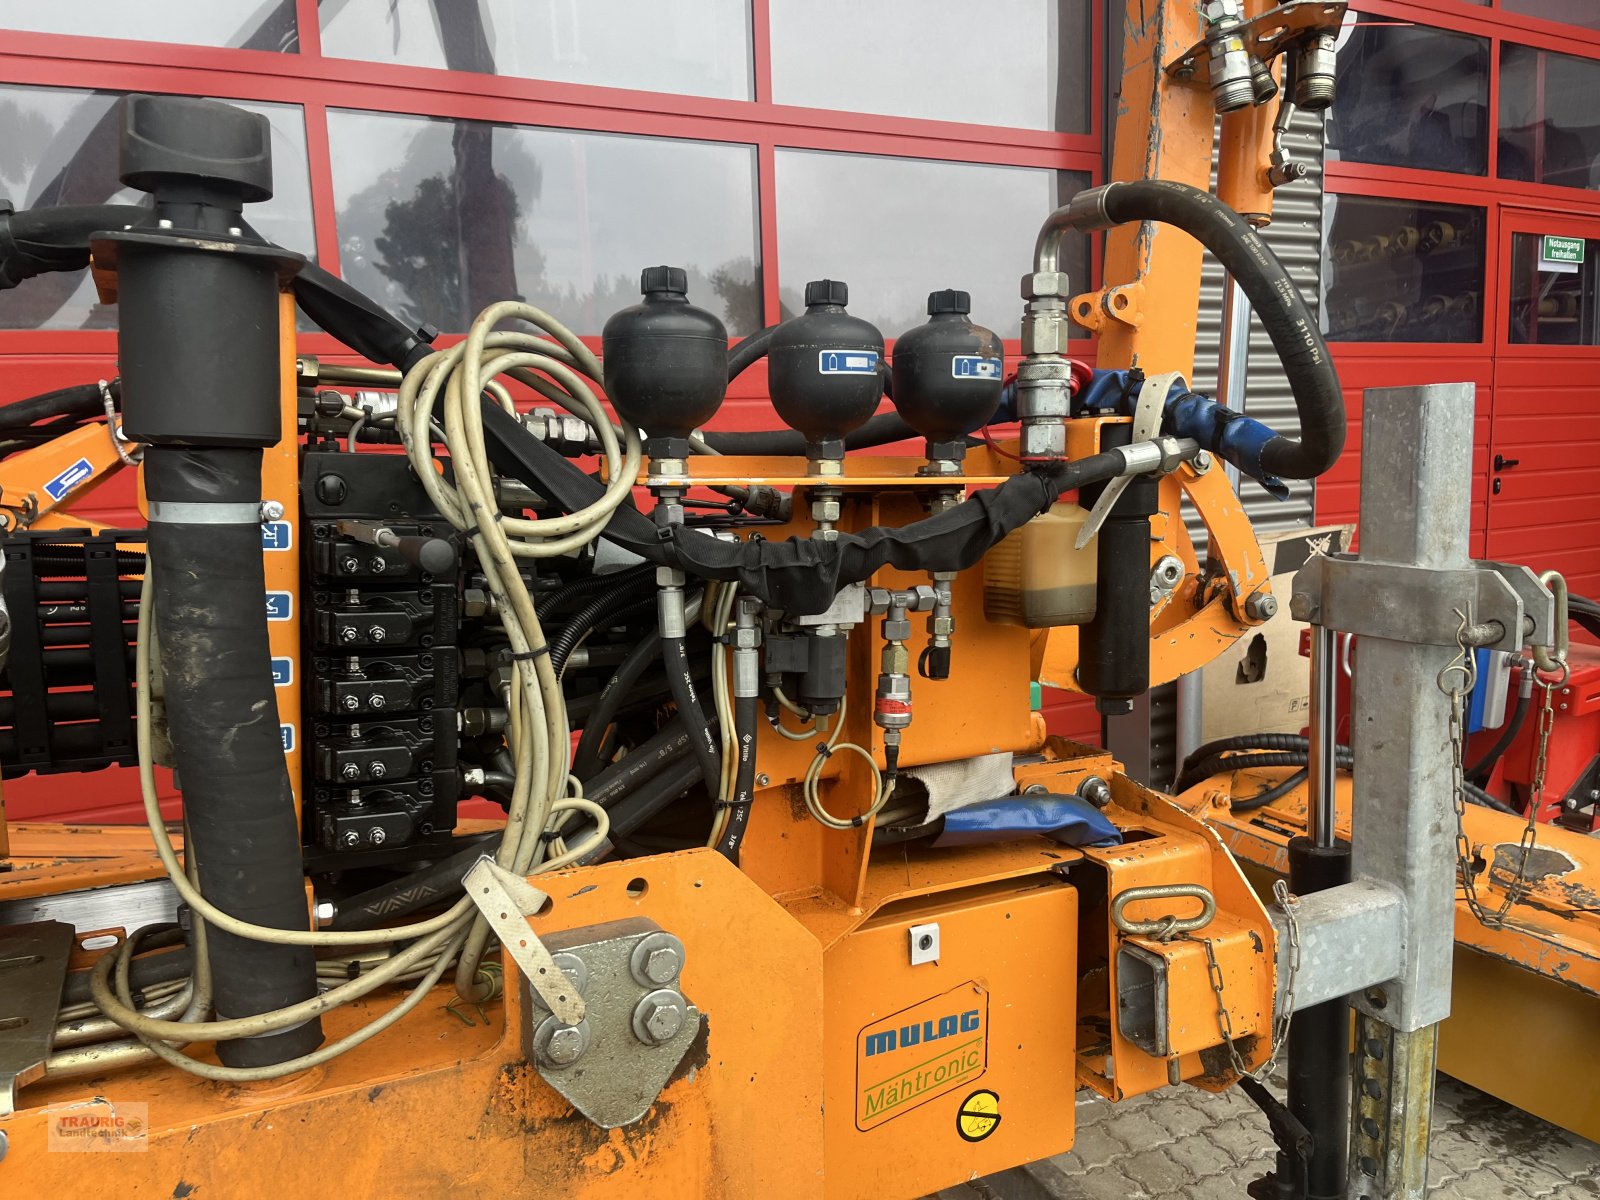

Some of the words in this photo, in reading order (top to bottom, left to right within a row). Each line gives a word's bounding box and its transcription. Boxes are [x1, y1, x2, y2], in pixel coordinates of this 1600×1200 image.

[1548, 238, 1580, 251] Notausgang
[1551, 248, 1577, 260] freihalten
[1296, 318, 1315, 347] 3110
[1309, 347, 1323, 365] Psi
[742, 744, 750, 762] Vitillo
[735, 808, 745, 822] 2SC
[865, 1009, 980, 1057] MULAG
[865, 1050, 979, 1116] Mähtronic
